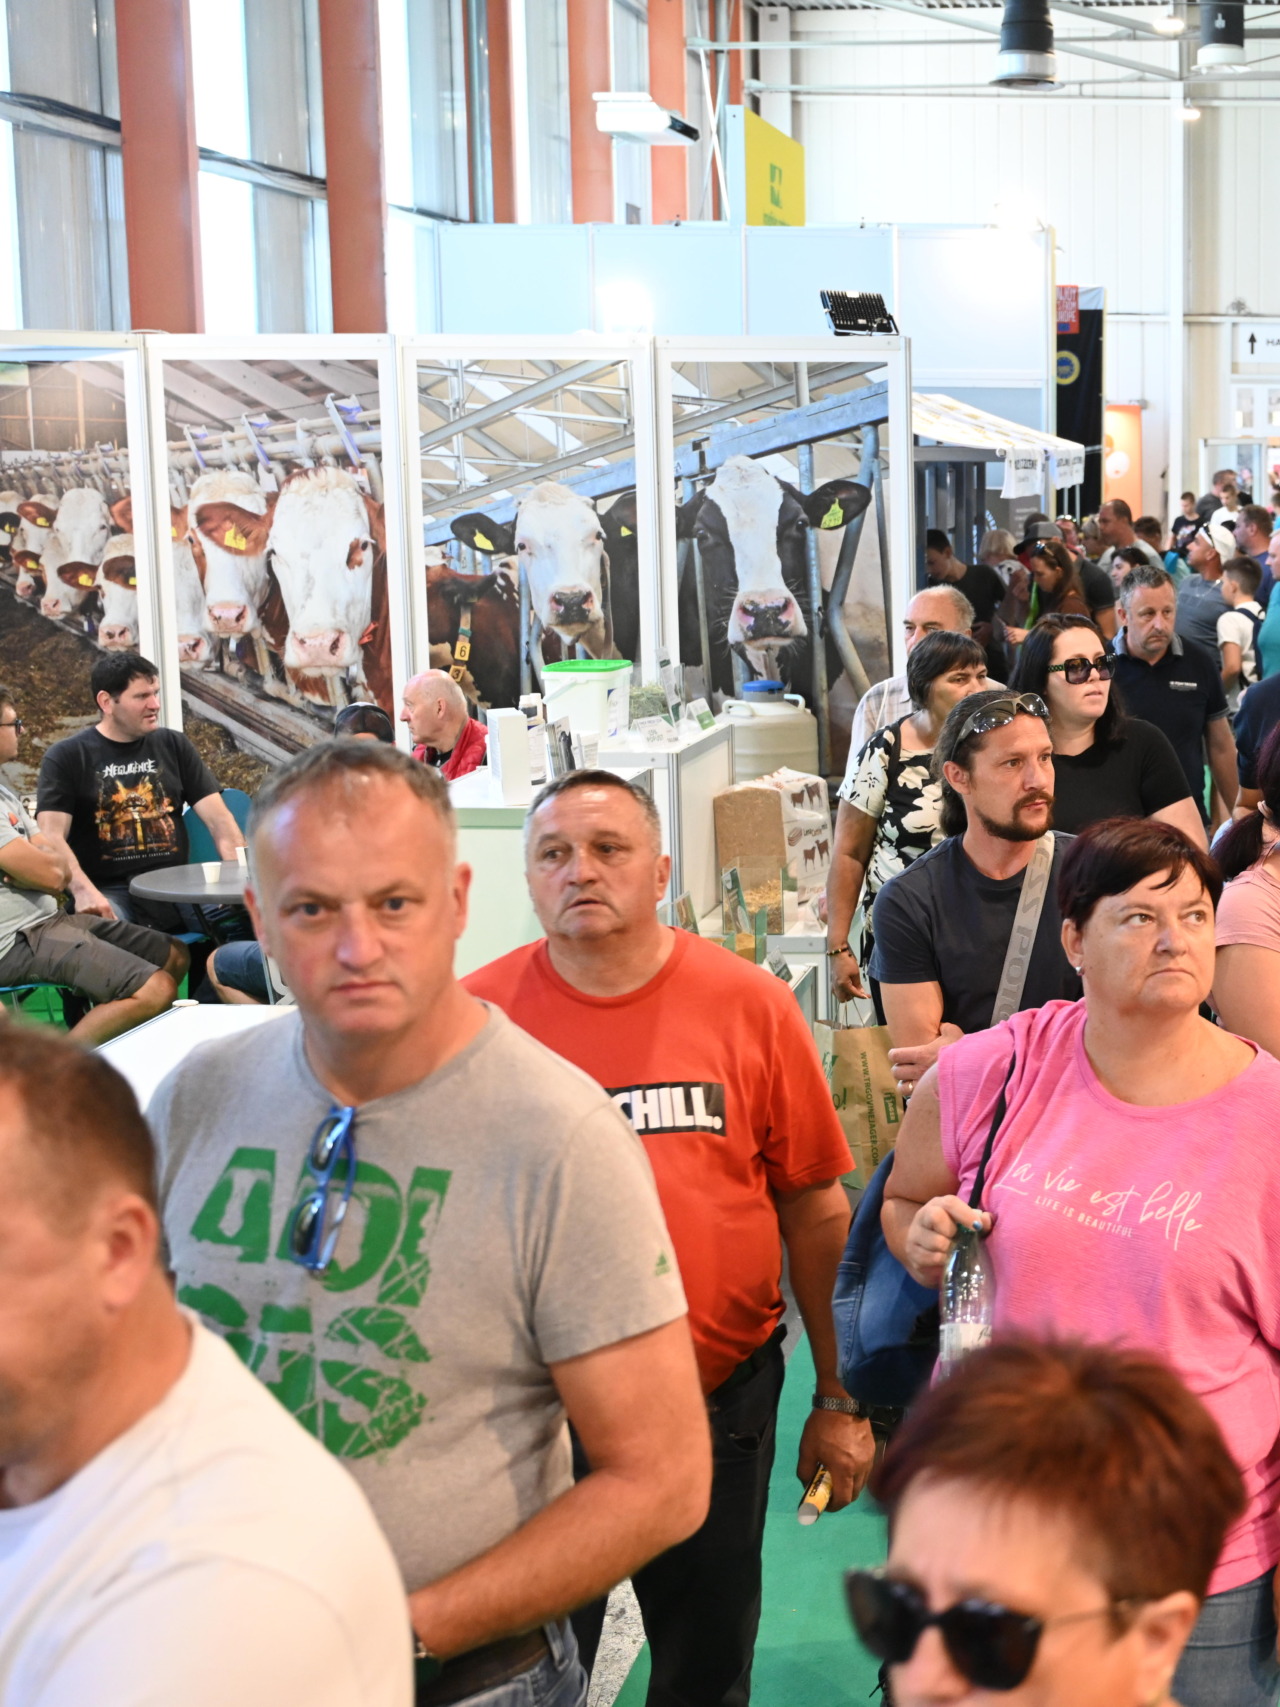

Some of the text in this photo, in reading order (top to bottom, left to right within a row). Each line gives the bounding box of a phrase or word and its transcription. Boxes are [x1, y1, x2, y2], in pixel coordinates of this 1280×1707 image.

[102, 759, 157, 778] NEGLIGENCE
[860, 1051, 879, 1166] WWW.TRGOVINEJAGER.COM
[992, 1149, 1203, 1251] La vie est belle
[1035, 1195, 1134, 1238] LIFE IS BEAUTIFUL
